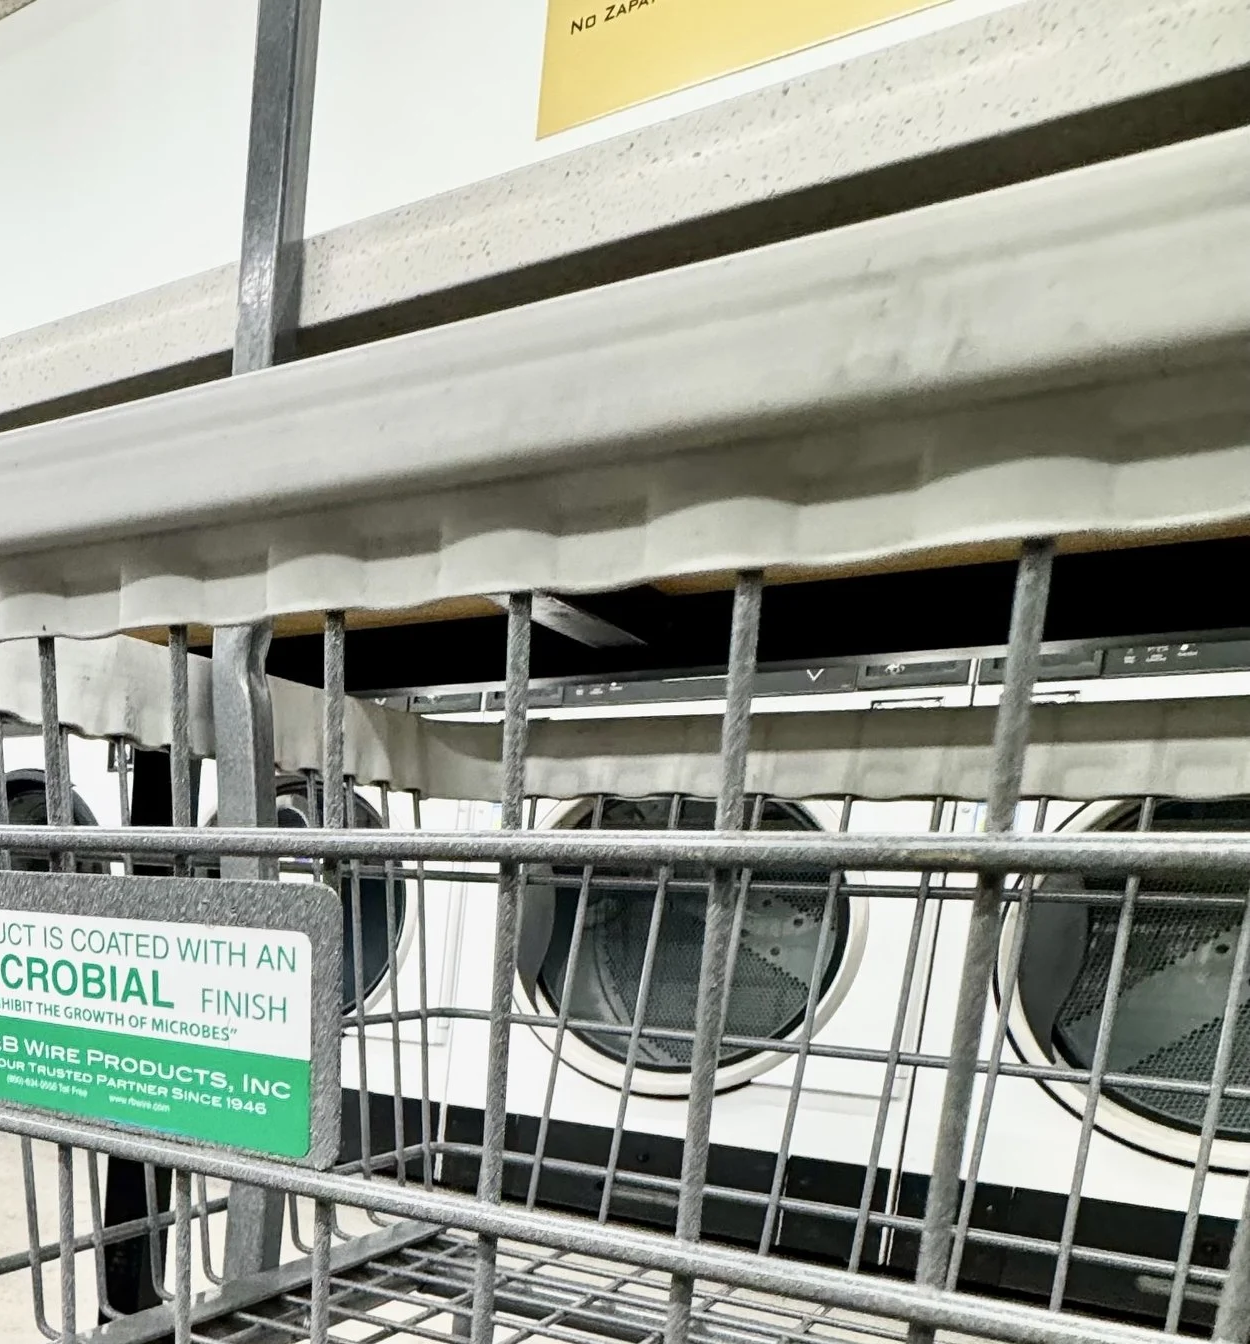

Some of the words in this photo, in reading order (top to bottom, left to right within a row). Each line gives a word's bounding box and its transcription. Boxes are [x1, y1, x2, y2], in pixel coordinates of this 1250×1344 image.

[571, 14, 596, 35] NO
[604, 0, 655, 22] ZAPA
[43, 926, 64, 950] IS
[71, 928, 170, 960] COATED
[177, 937, 246, 968] WITH
[256, 944, 296, 973] AN
[37, 1001, 60, 1017] THE
[64, 1005, 124, 1026] GROWTH
[129, 1015, 147, 1029] OF
[202, 988, 287, 1024] FINISH
[23, 1038, 81, 1065] WIRE
[87, 1049, 234, 1093] PRODUCTS,
[243, 1074, 291, 1099] INC
[28, 1061, 93, 1083] TRUSTED
[96, 1075, 168, 1097] PARTNER
[171, 1087, 222, 1108] SINCE
[226, 1097, 267, 1115] 1946
